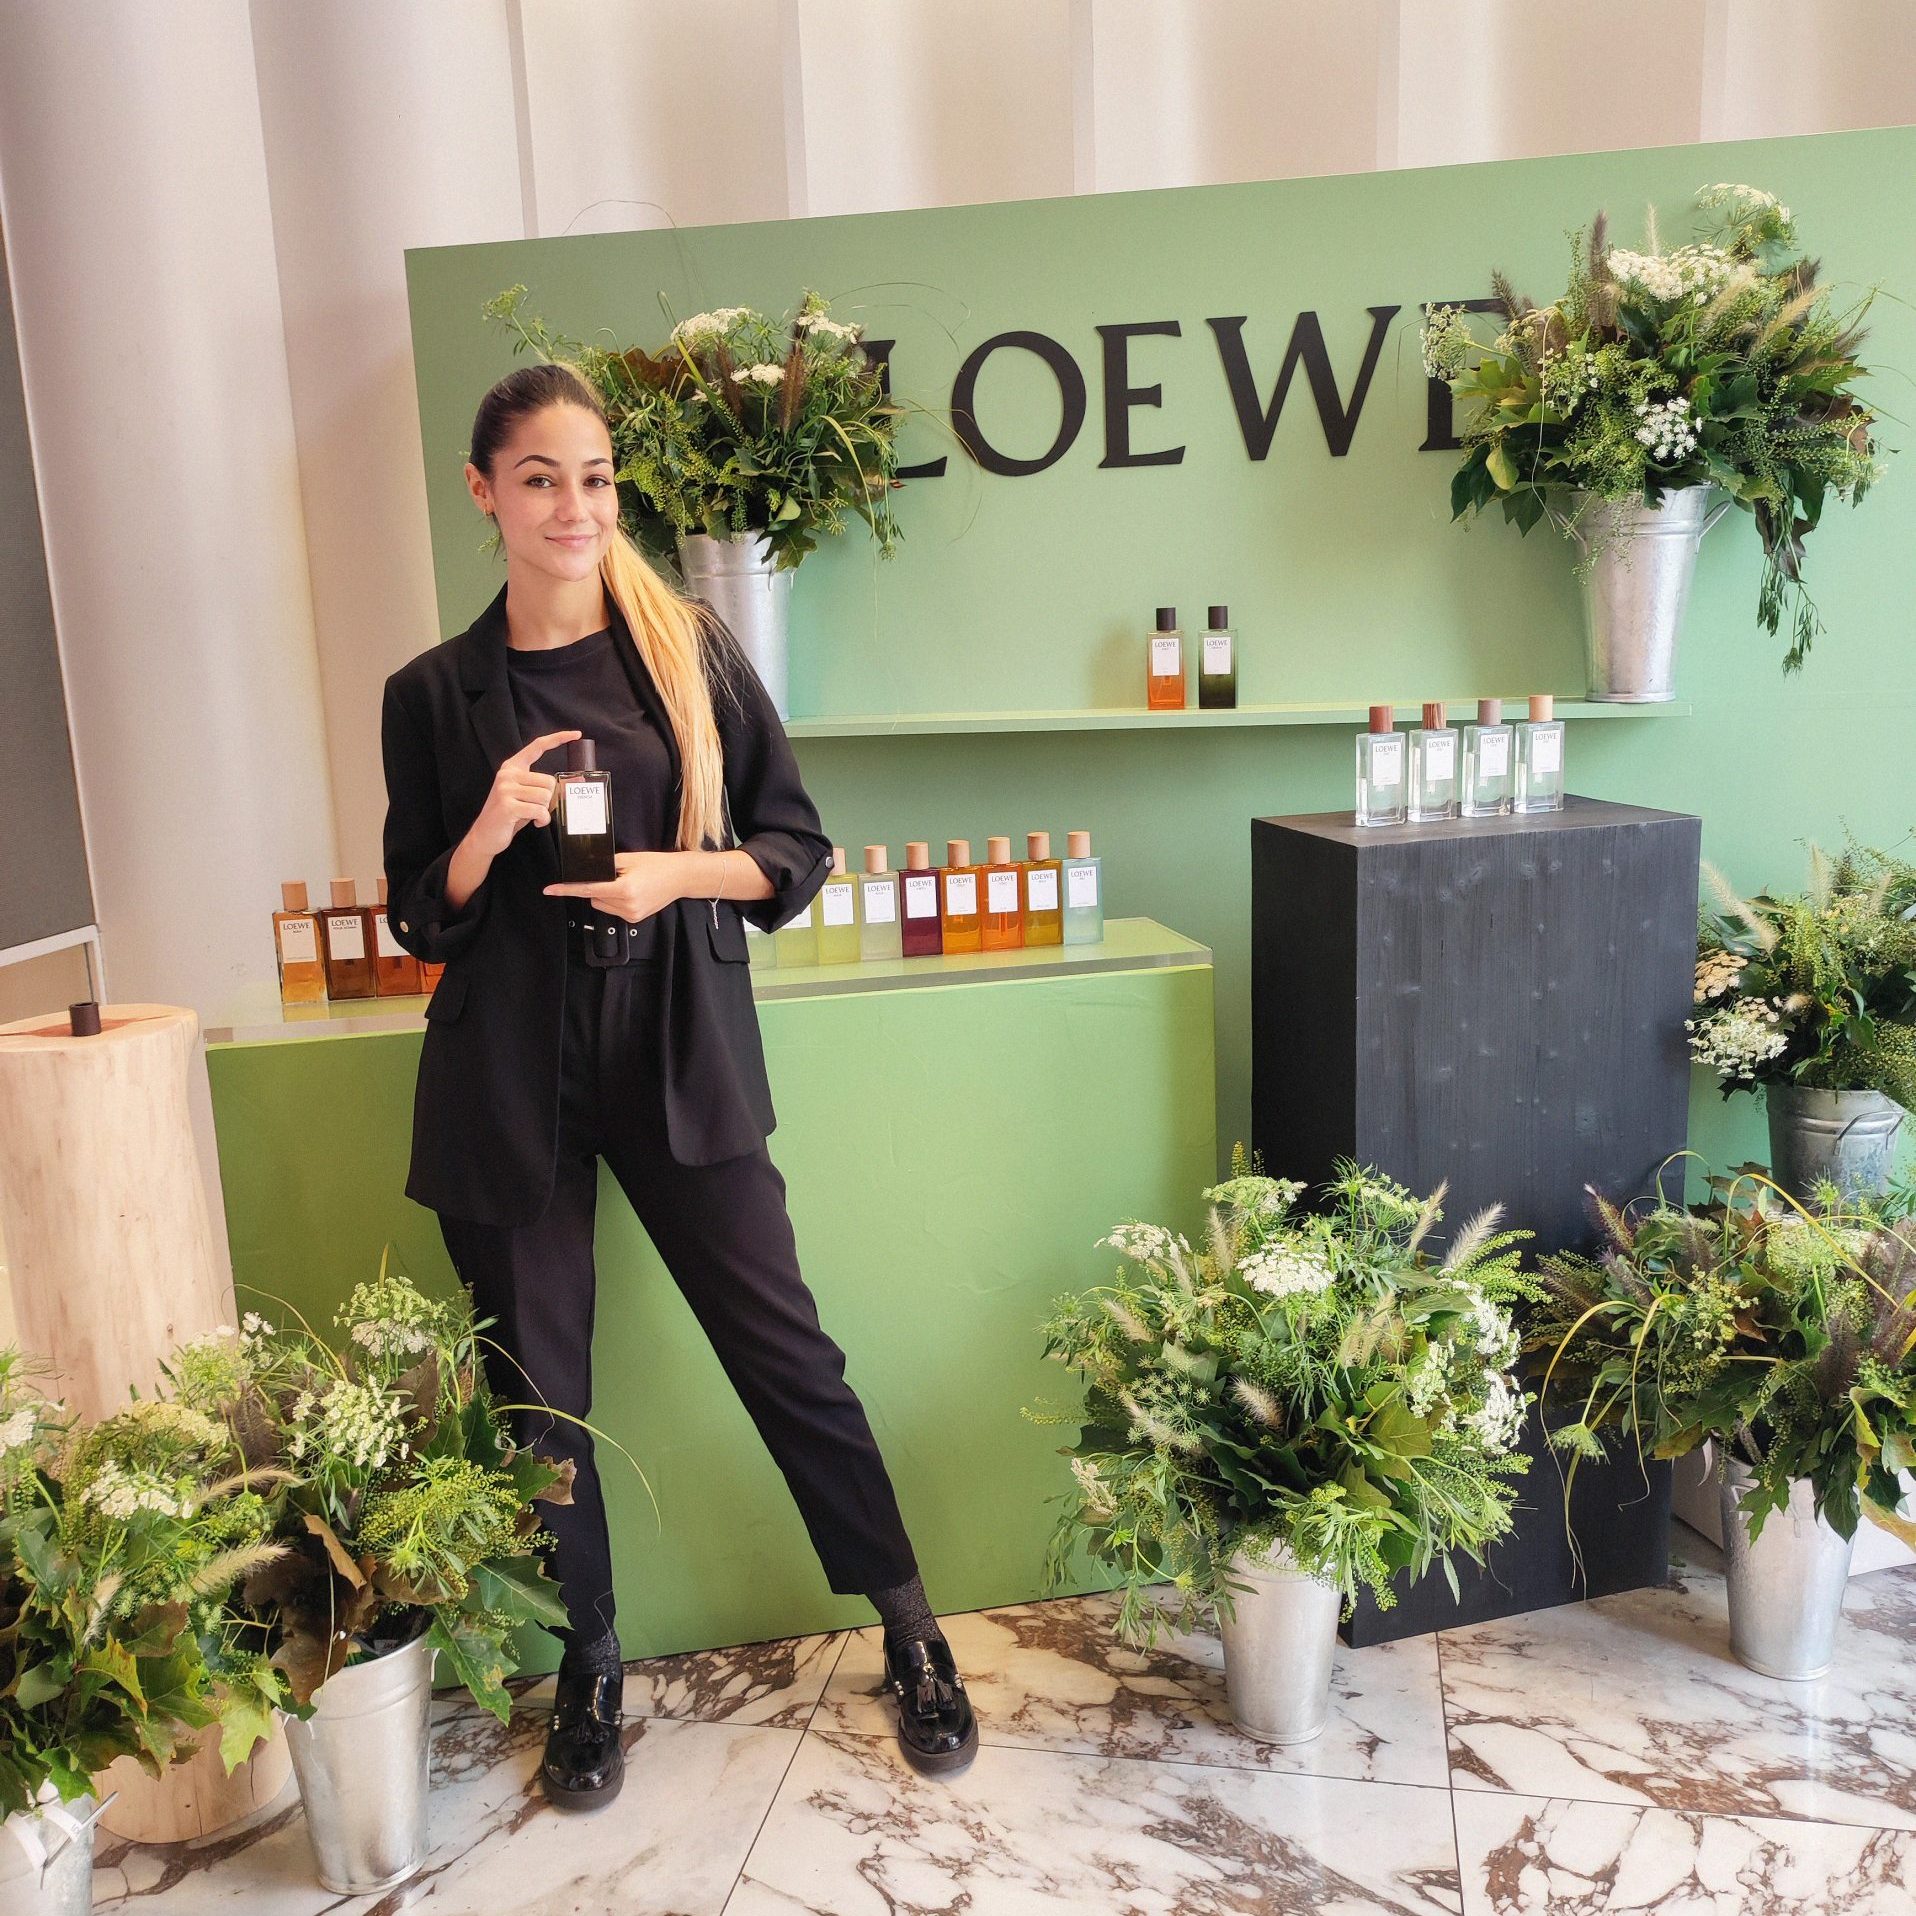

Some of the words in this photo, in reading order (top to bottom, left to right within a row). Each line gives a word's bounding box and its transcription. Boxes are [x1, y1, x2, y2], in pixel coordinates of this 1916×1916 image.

[1483, 736, 1505, 744] LOEWE
[1535, 733, 1557, 741] LOEWE
[1375, 744, 1398, 752] LOEWE
[1428, 740, 1450, 748] LOEWE
[569, 786, 600, 795] LOEWE
[1031, 872, 1053, 880] LOEWE
[1070, 869, 1093, 877] LOEWE
[991, 874, 1014, 882] LOEWE
[909, 879, 932, 887] LOEWE
[867, 884, 890, 892] LOEWE
[283, 921, 311, 931] LOEWE
[331, 918, 358, 927] LOEWE
